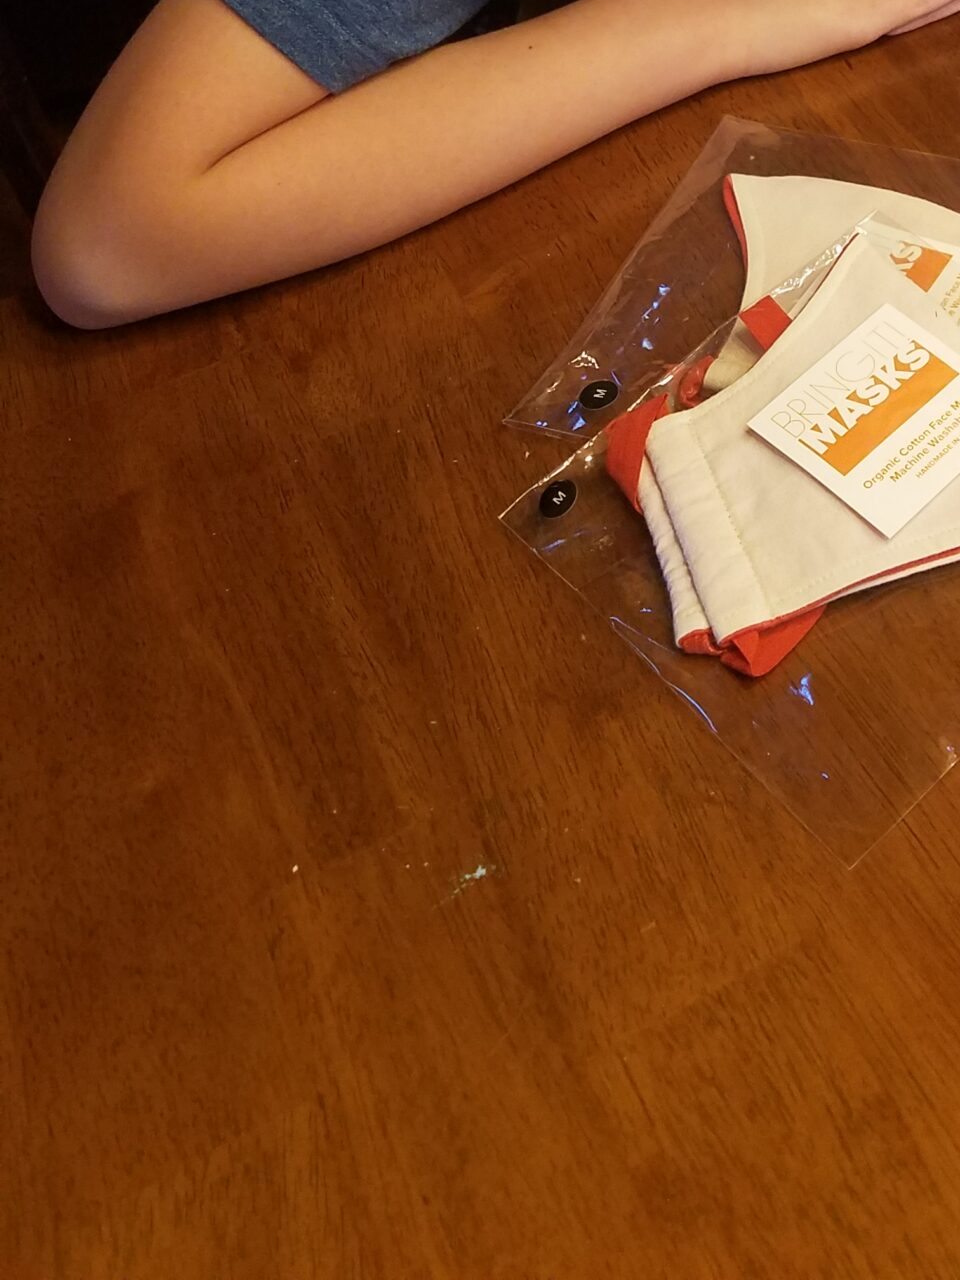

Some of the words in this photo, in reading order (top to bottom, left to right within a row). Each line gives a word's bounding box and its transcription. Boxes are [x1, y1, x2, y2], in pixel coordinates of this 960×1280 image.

[593, 389, 608, 399] M
[799, 338, 931, 455] MASKS
[863, 455, 902, 490] Organic
[899, 428, 931, 457] Cotton
[928, 410, 953, 431] Face
[890, 446, 930, 483] Machine
[915, 444, 952, 479] HANDMADE
[552, 491, 567, 505] M
